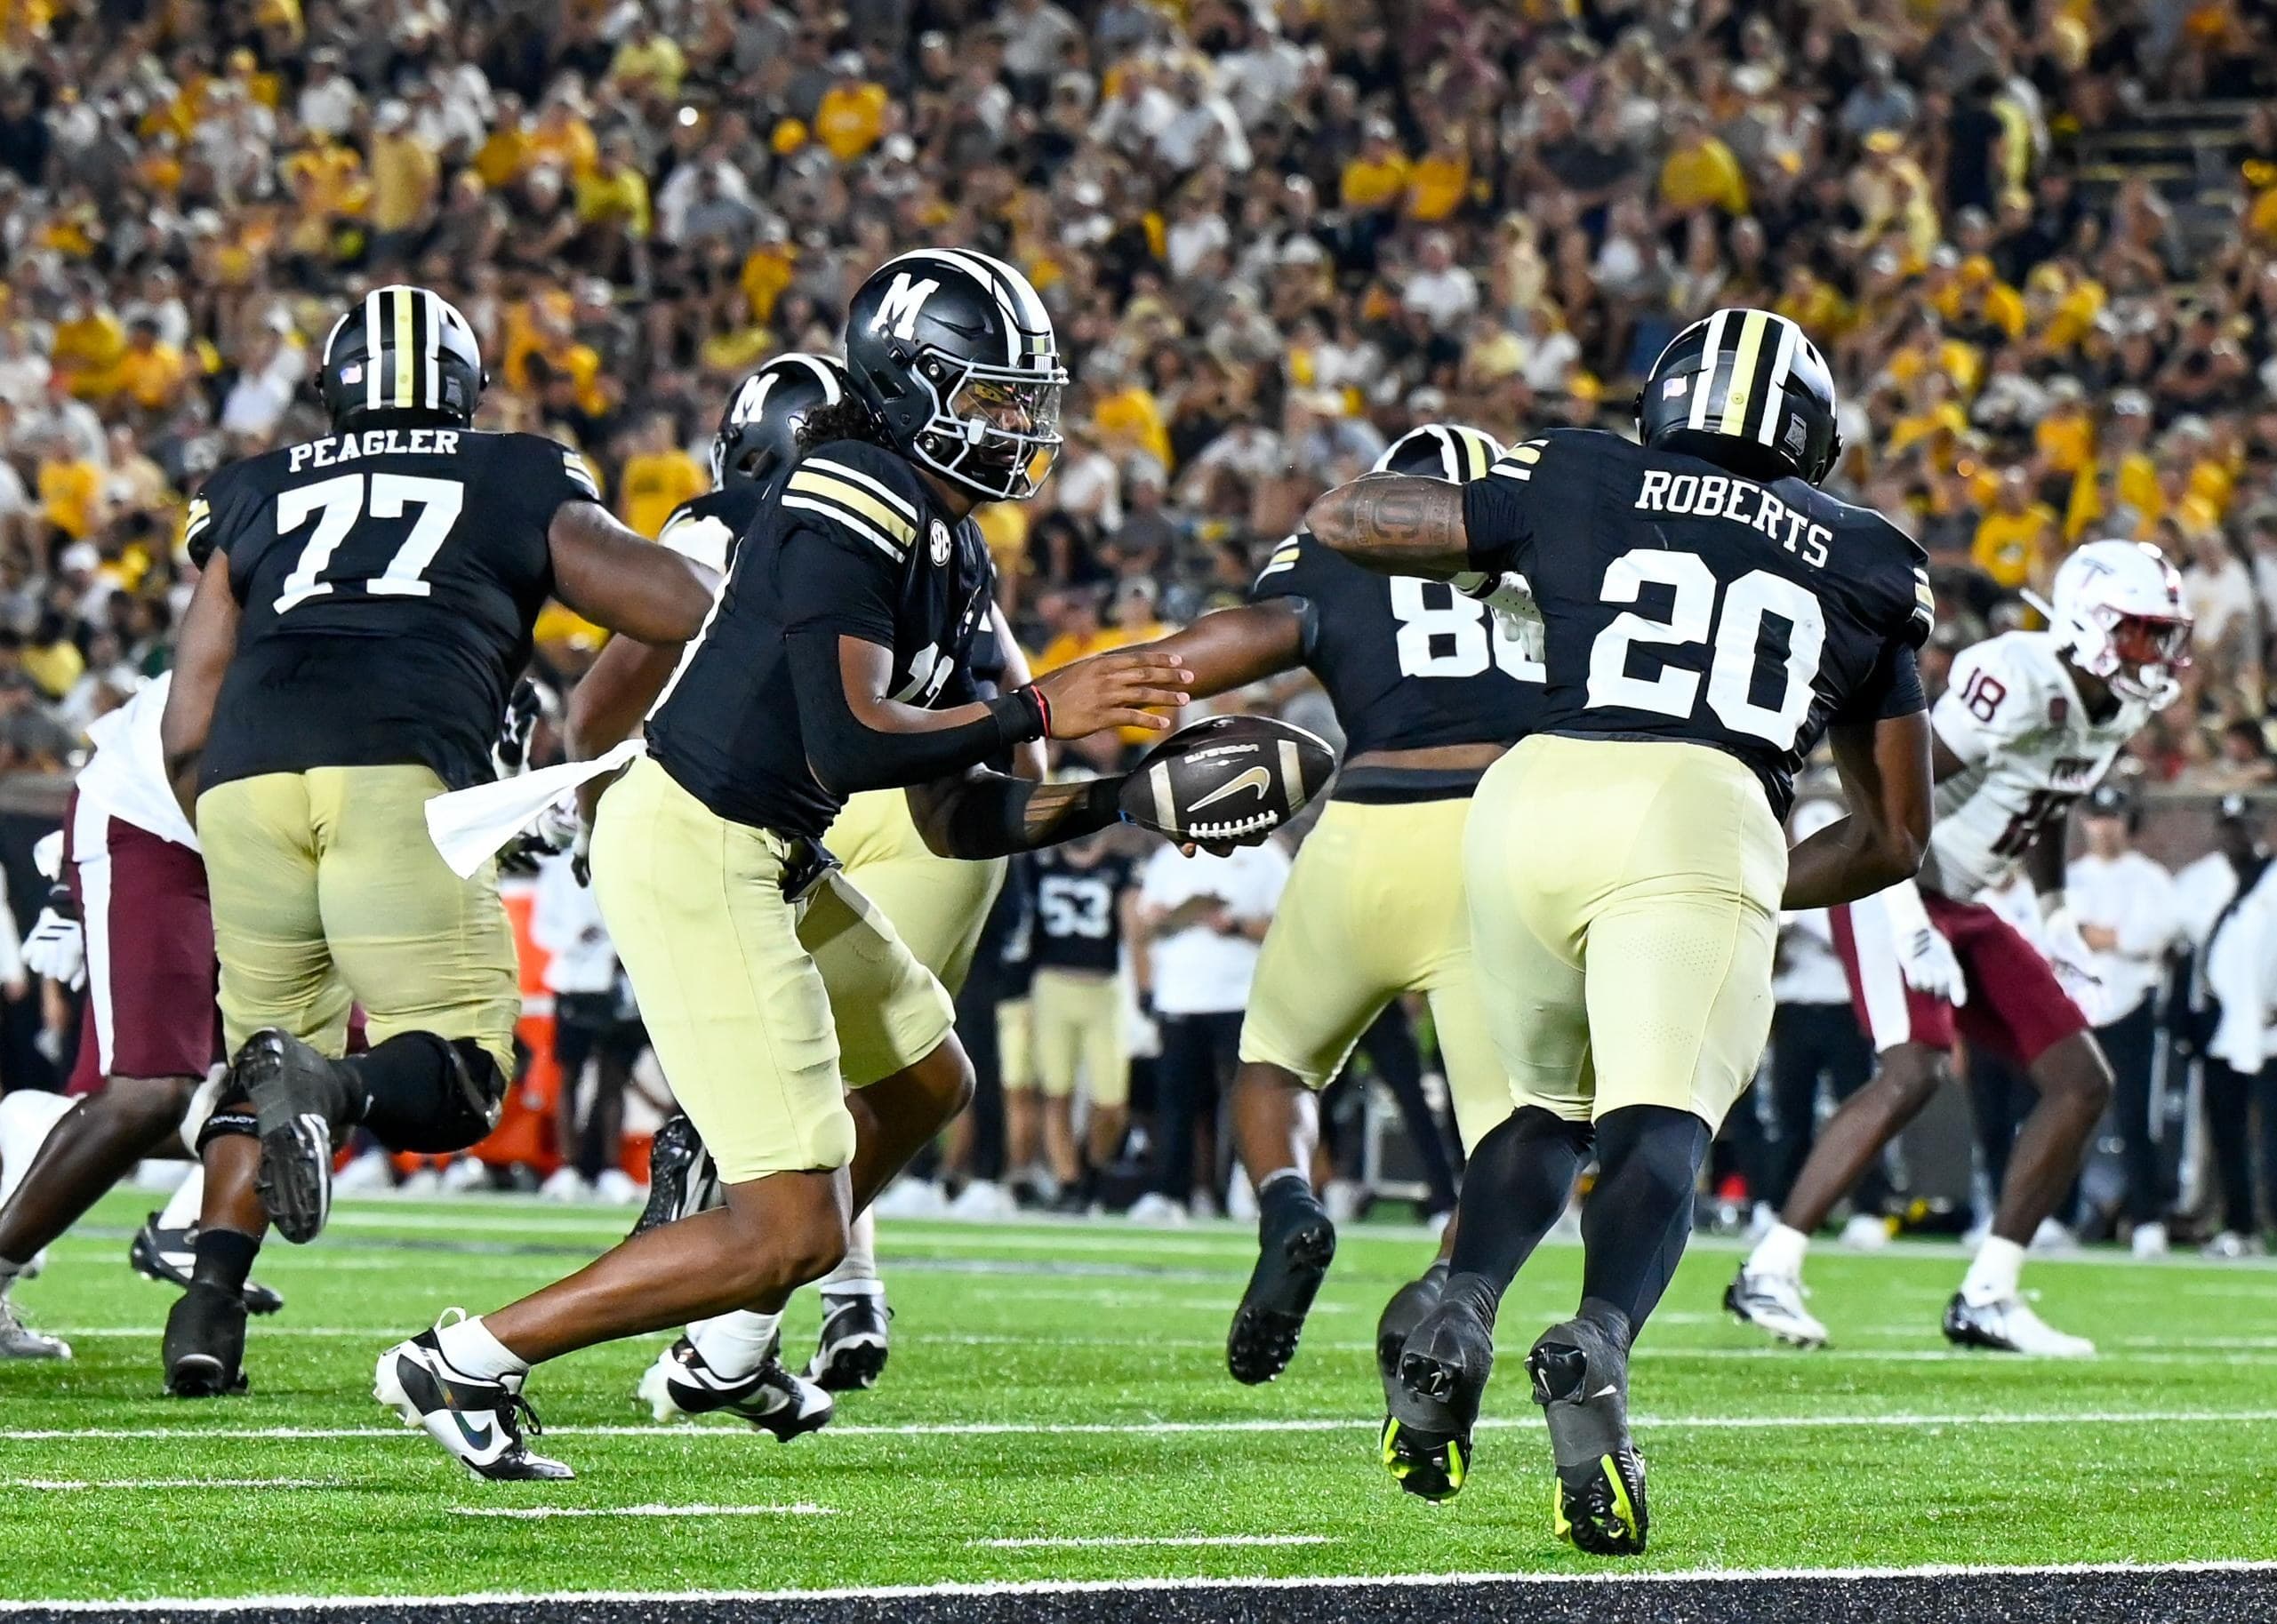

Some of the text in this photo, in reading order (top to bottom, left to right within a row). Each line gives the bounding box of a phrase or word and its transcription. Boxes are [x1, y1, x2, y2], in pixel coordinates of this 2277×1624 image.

[864, 272, 941, 341] M
[731, 372, 780, 424] M
[289, 429, 460, 473] PEAGLER
[273, 473, 464, 615] 77
[1634, 470, 1833, 568] ROBERTS
[1583, 548, 1826, 752] 20
[1960, 667, 2007, 723] 18
[1038, 876, 1112, 939] 53
